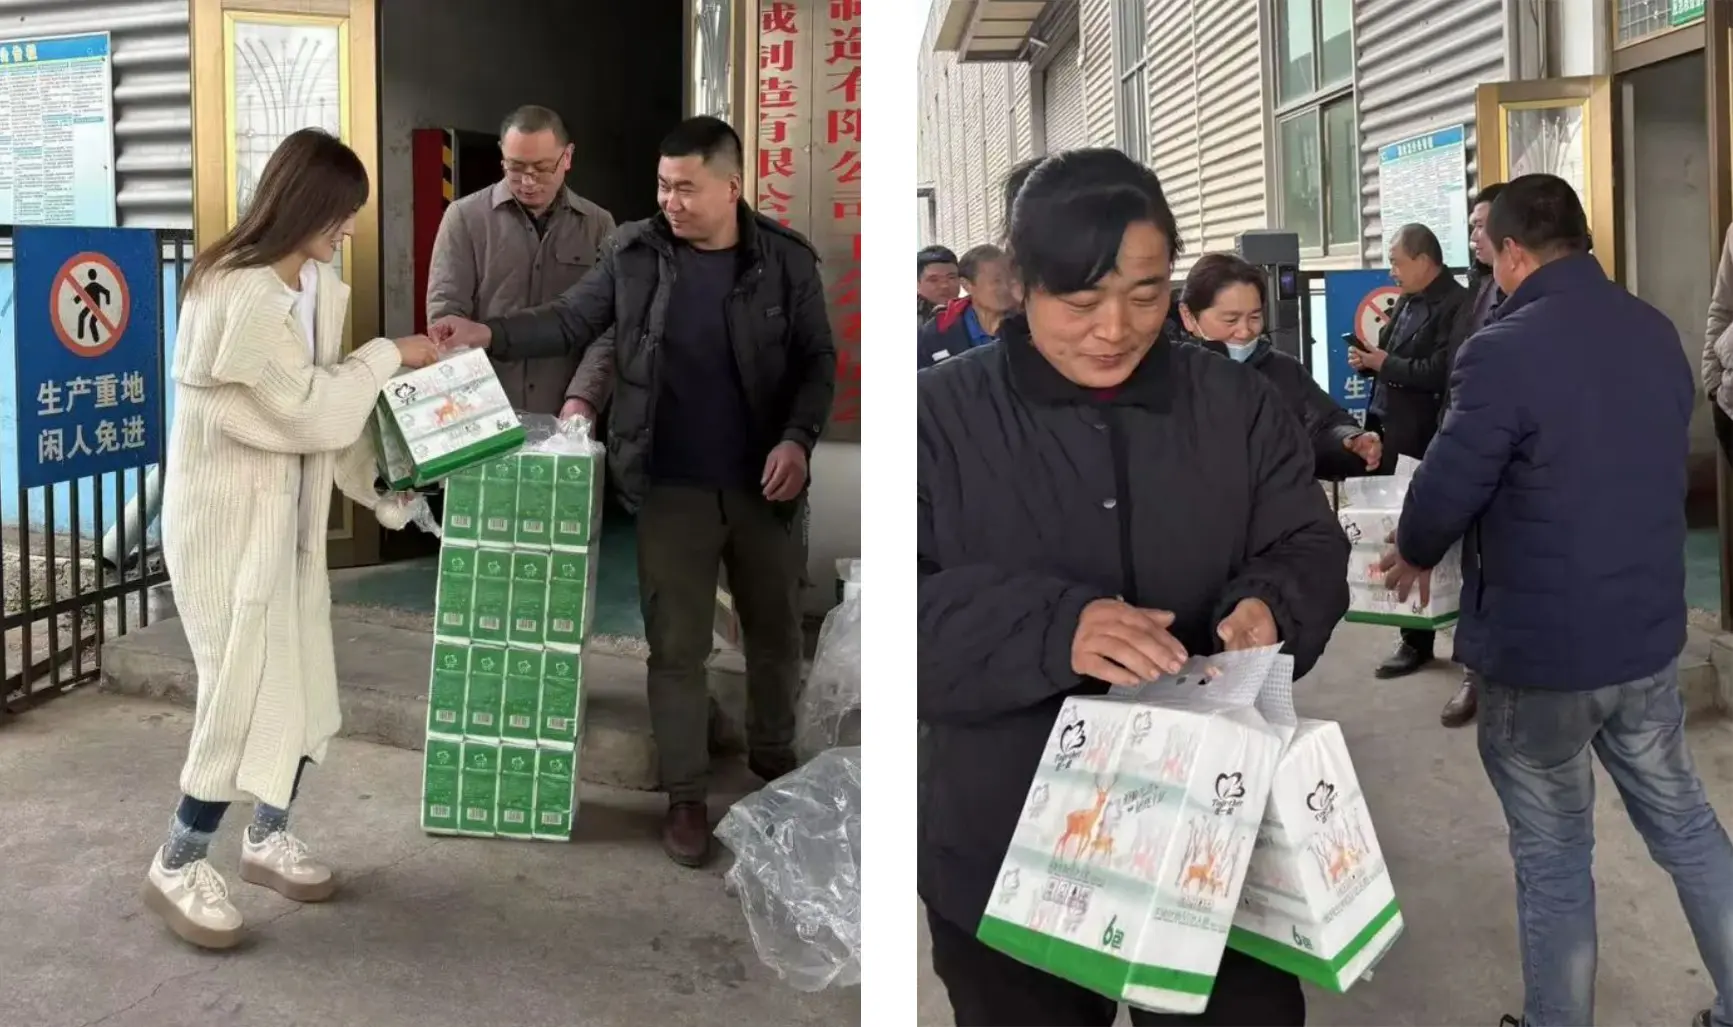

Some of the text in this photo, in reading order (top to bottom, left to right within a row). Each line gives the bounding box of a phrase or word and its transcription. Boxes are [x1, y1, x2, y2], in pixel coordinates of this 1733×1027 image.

[36, 370, 145, 416] 生产重地
[38, 416, 146, 464] 闲人免进
